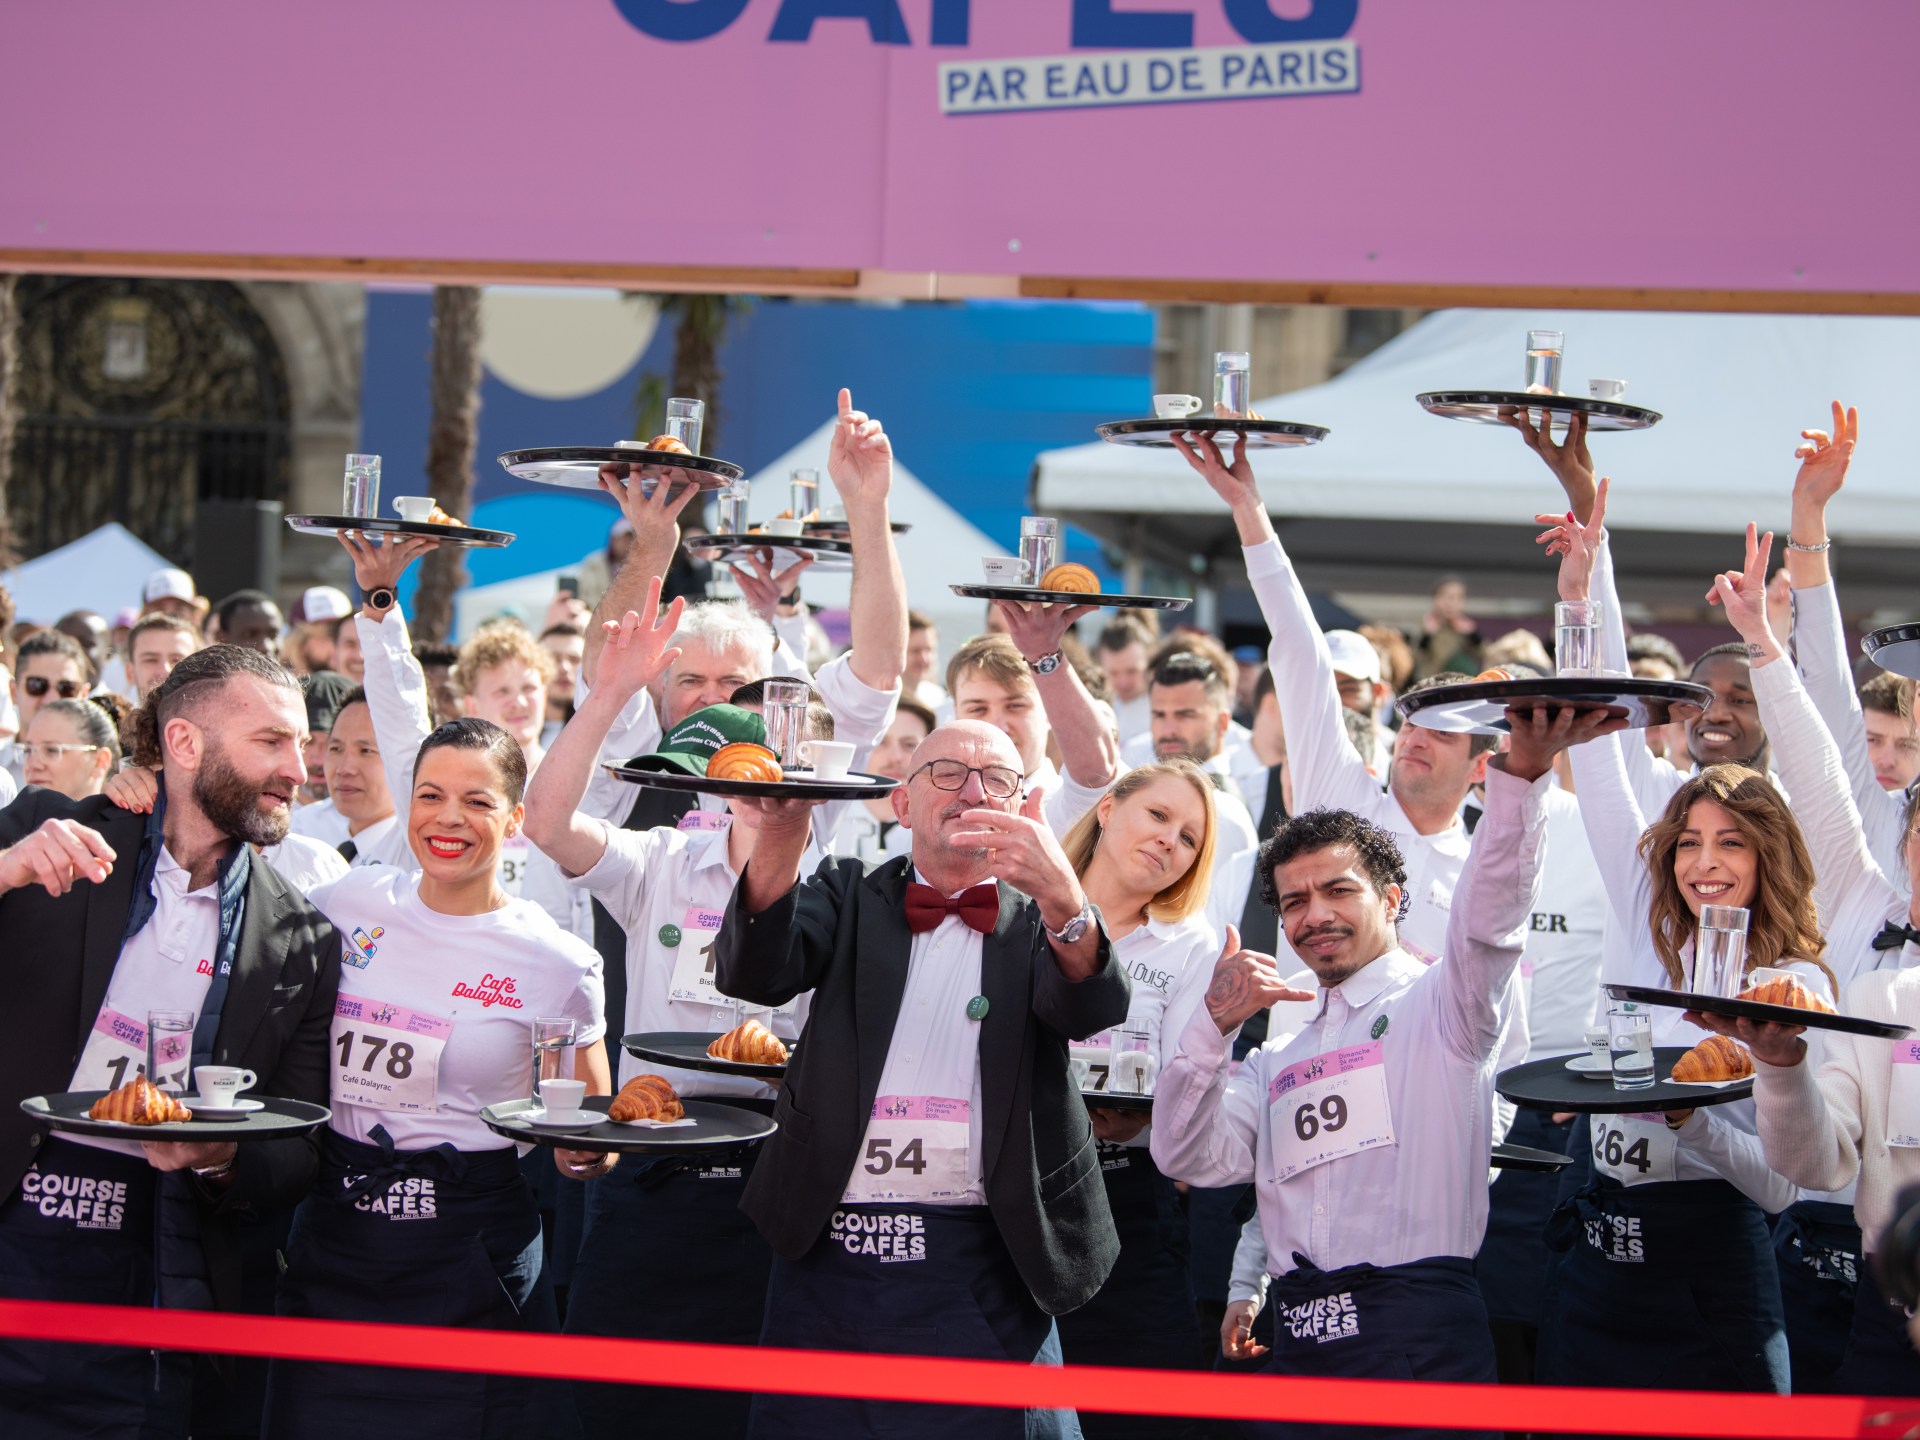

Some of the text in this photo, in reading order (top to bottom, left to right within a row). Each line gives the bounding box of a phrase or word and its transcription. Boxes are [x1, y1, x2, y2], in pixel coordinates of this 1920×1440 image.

[947, 49, 1348, 104] PAR EAU DE PARIS
[695, 720, 729, 745] Raymond
[451, 982, 523, 1009] Dalayrac
[480, 973, 516, 993] Café
[411, 1014, 442, 1027] Dimanche
[337, 1030, 414, 1080] 178
[1338, 1048, 1371, 1060] Dimanche
[342, 1074, 392, 1092] Café Dalayrac
[925, 1100, 957, 1110] Dimanche
[1294, 1094, 1348, 1142] 69
[864, 1138, 927, 1175] 54
[1595, 1123, 1651, 1173] 264
[22, 1172, 127, 1203] COURSE
[23, 1193, 40, 1203] DES
[831, 1211, 925, 1236] COURSE
[830, 1232, 844, 1241] DES
